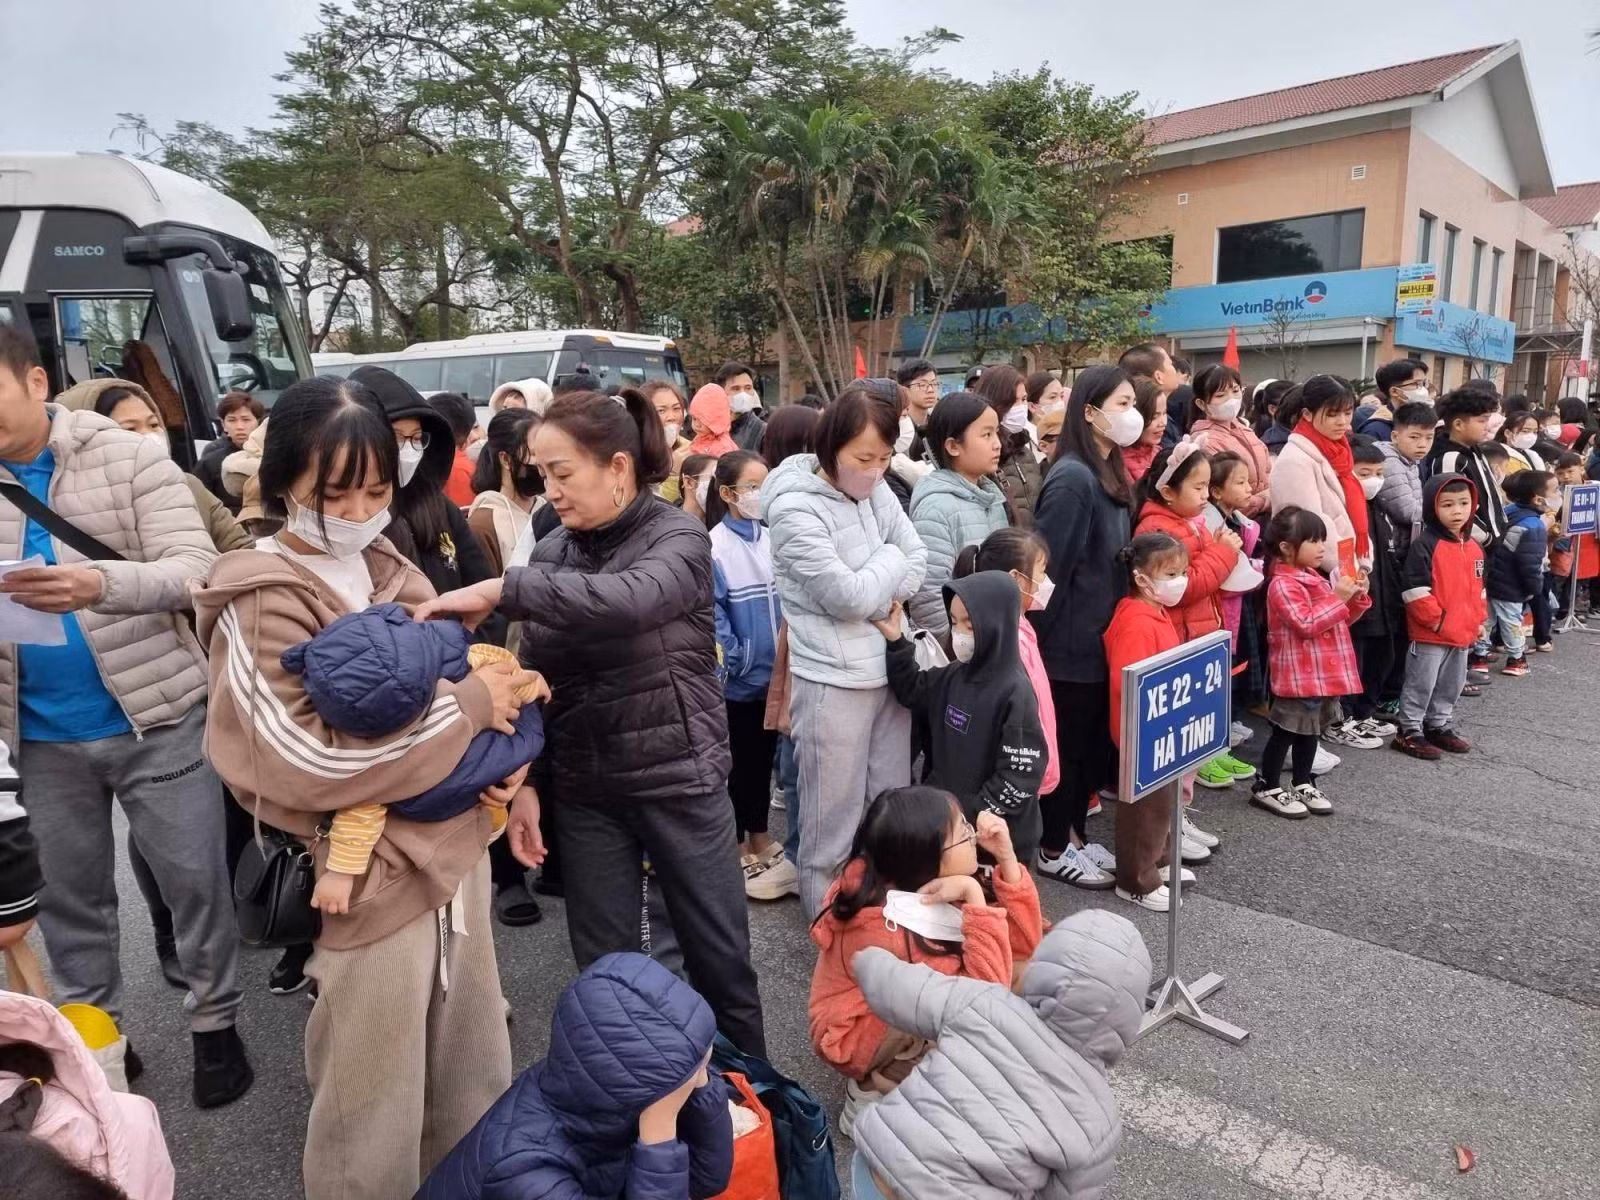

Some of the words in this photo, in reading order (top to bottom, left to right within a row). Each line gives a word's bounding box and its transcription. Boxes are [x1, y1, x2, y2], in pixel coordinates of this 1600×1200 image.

[54, 245, 105, 257] SAMCO
[1220, 296, 1305, 316] VietinBank
[1147, 683, 1168, 721] XE
[1172, 673, 1191, 711] 22
[1205, 660, 1222, 694] 24
[1002, 745, 1019, 755] Nice
[1153, 726, 1176, 772] HÀ
[1181, 712, 1216, 757] TĨNH
[1010, 755, 1019, 763] to
[641, 906, 651, 942] WINTER
